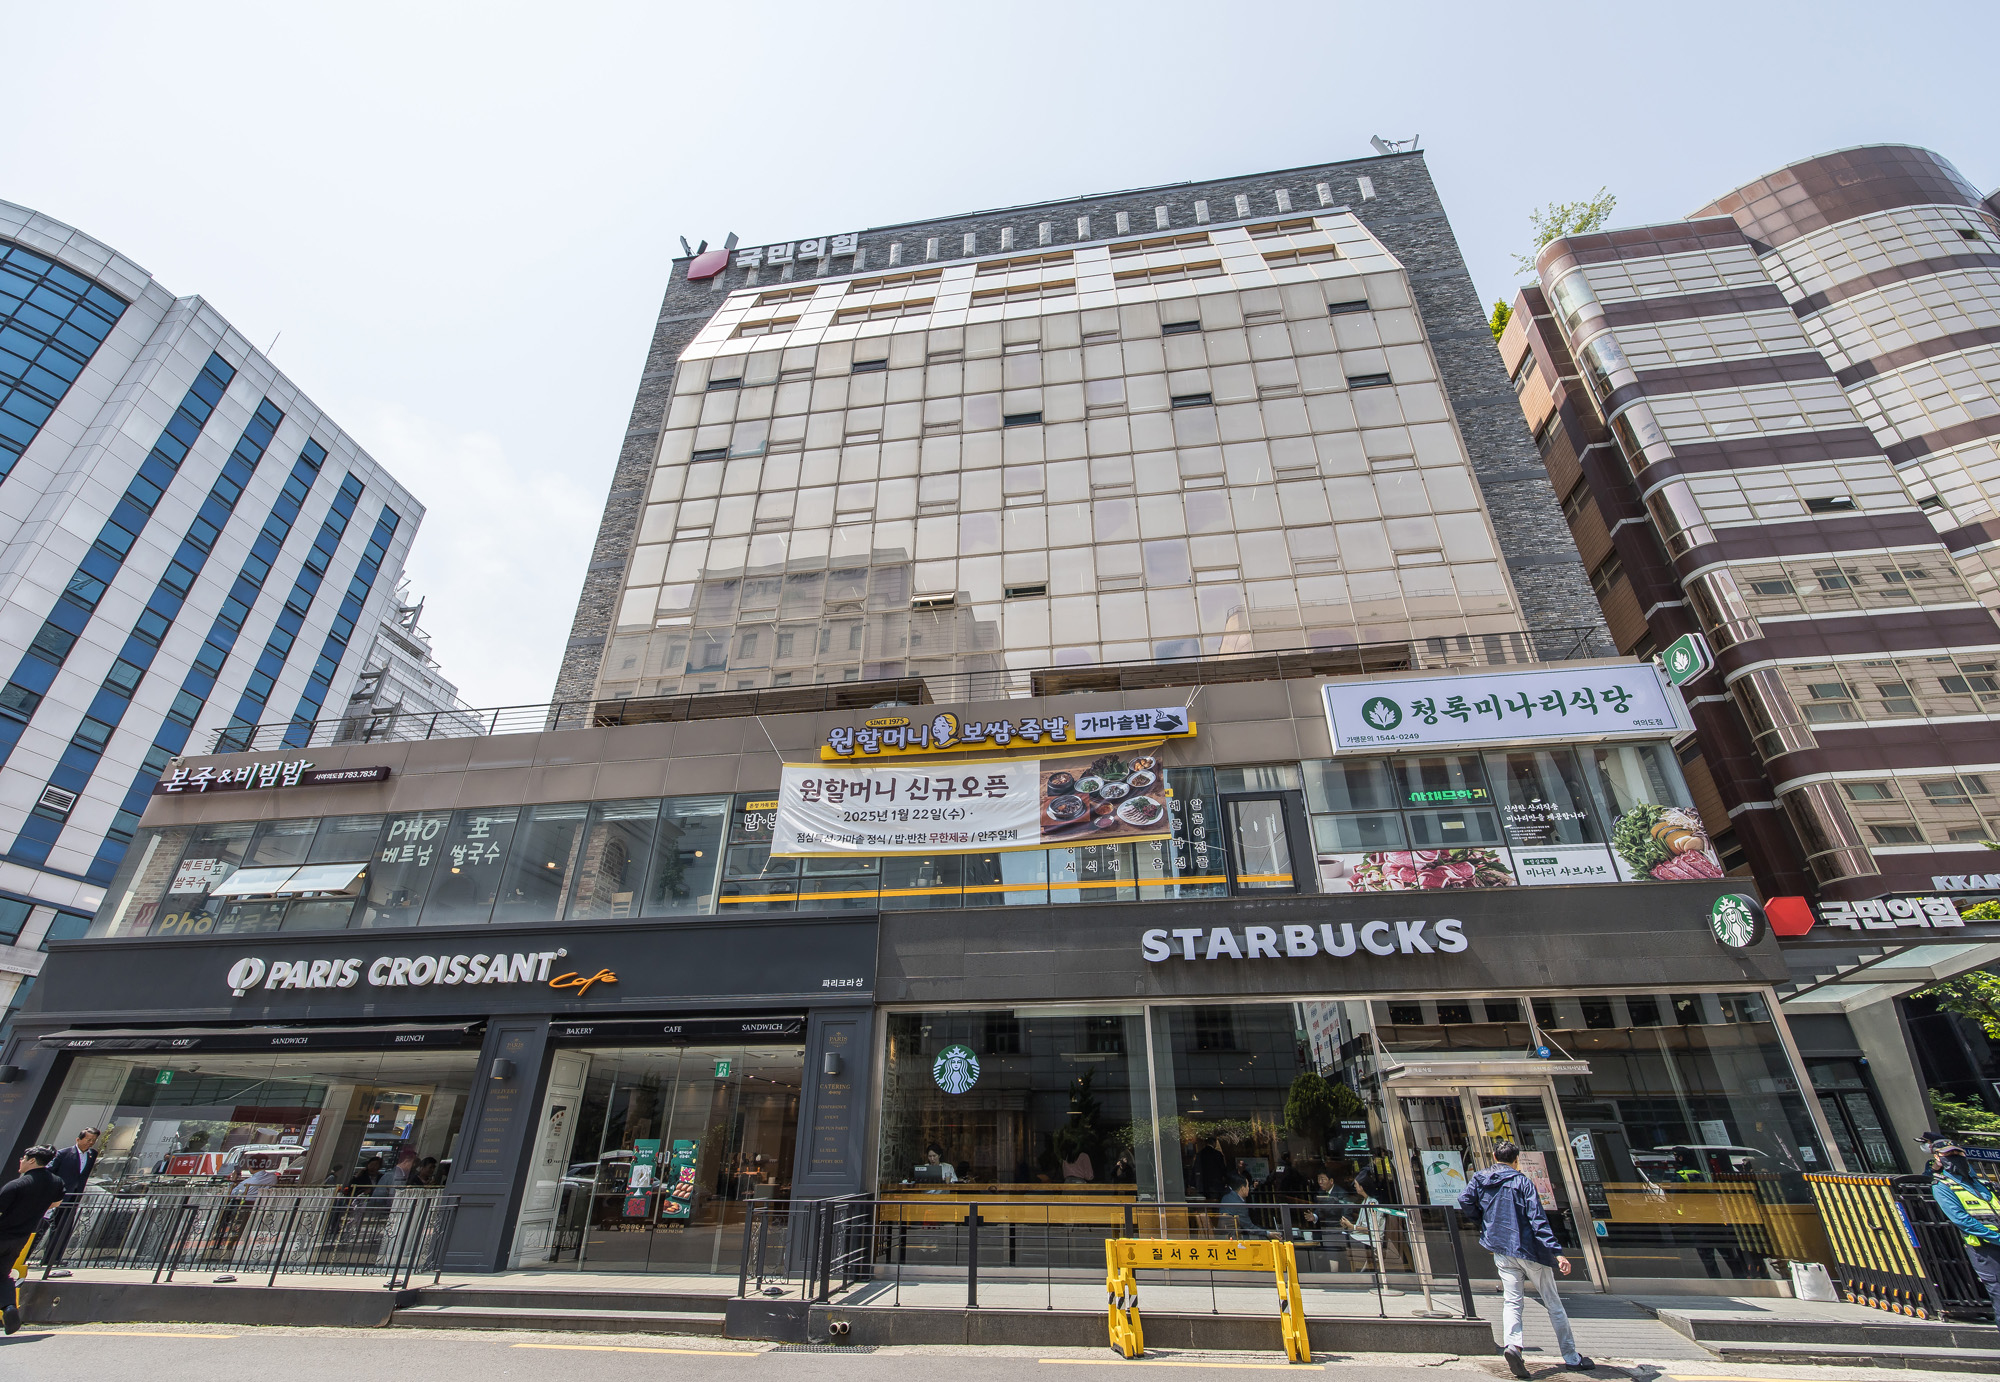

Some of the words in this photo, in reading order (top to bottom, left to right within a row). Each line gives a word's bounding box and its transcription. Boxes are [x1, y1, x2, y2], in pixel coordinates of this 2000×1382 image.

[735, 232, 859, 268] 국민의힘
[1410, 685, 1633, 725] 청록미나리식당
[1080, 713, 1152, 733] 가마솥밥
[1633, 718, 1664, 727] 여의도점
[960, 715, 1070, 744] 보쌈·족발
[827, 723, 928, 755] 원할머니
[1346, 735, 1374, 743] 가맹문의
[1376, 732, 1420, 742] 1544-0249
[344, 769, 378, 779] 783.7834
[799, 777, 897, 804] 원할머니
[905, 774, 1010, 802] 신규오픈
[1503, 803, 1527, 813] 신선한
[1527, 802, 1559, 811] 산지직송
[843, 810, 888, 823] 2025년
[891, 808, 909, 821] 1월
[912, 807, 966, 821] 22일(수)
[1546, 811, 1587, 821] 제공합니다
[466, 816, 493, 839] 포
[1168, 799, 1186, 869] 해물파전
[866, 833, 887, 845] 정식
[928, 831, 969, 844] 무한제공
[977, 829, 1018, 842] 안주일체
[380, 844, 434, 867] 베트남
[449, 841, 500, 867] 쌀국수
[181, 859, 215, 872] 베트남
[1525, 866, 1557, 878] 미나리
[1560, 865, 1607, 877] 샤브샤브
[173, 876, 207, 889] 쌀국수
[1816, 897, 1966, 930] 국민의힘
[1142, 919, 1468, 962] STARBUCKS
[264, 958, 363, 990] PARIS
[367, 951, 558, 986] CROISSANT
[822, 978, 864, 988] 파리크라상
[566, 1027, 594, 1035] BAKERY
[664, 1025, 682, 1034] CAFE
[741, 1023, 783, 1032] SANDWICH
[68, 1039, 95, 1047] BAKERY
[271, 1037, 308, 1045] SANDWICH
[395, 1034, 425, 1043] BRUNCH
[1966, 1148, 1981, 1158] LICE
[1152, 1248, 1238, 1261] 질서유지선
